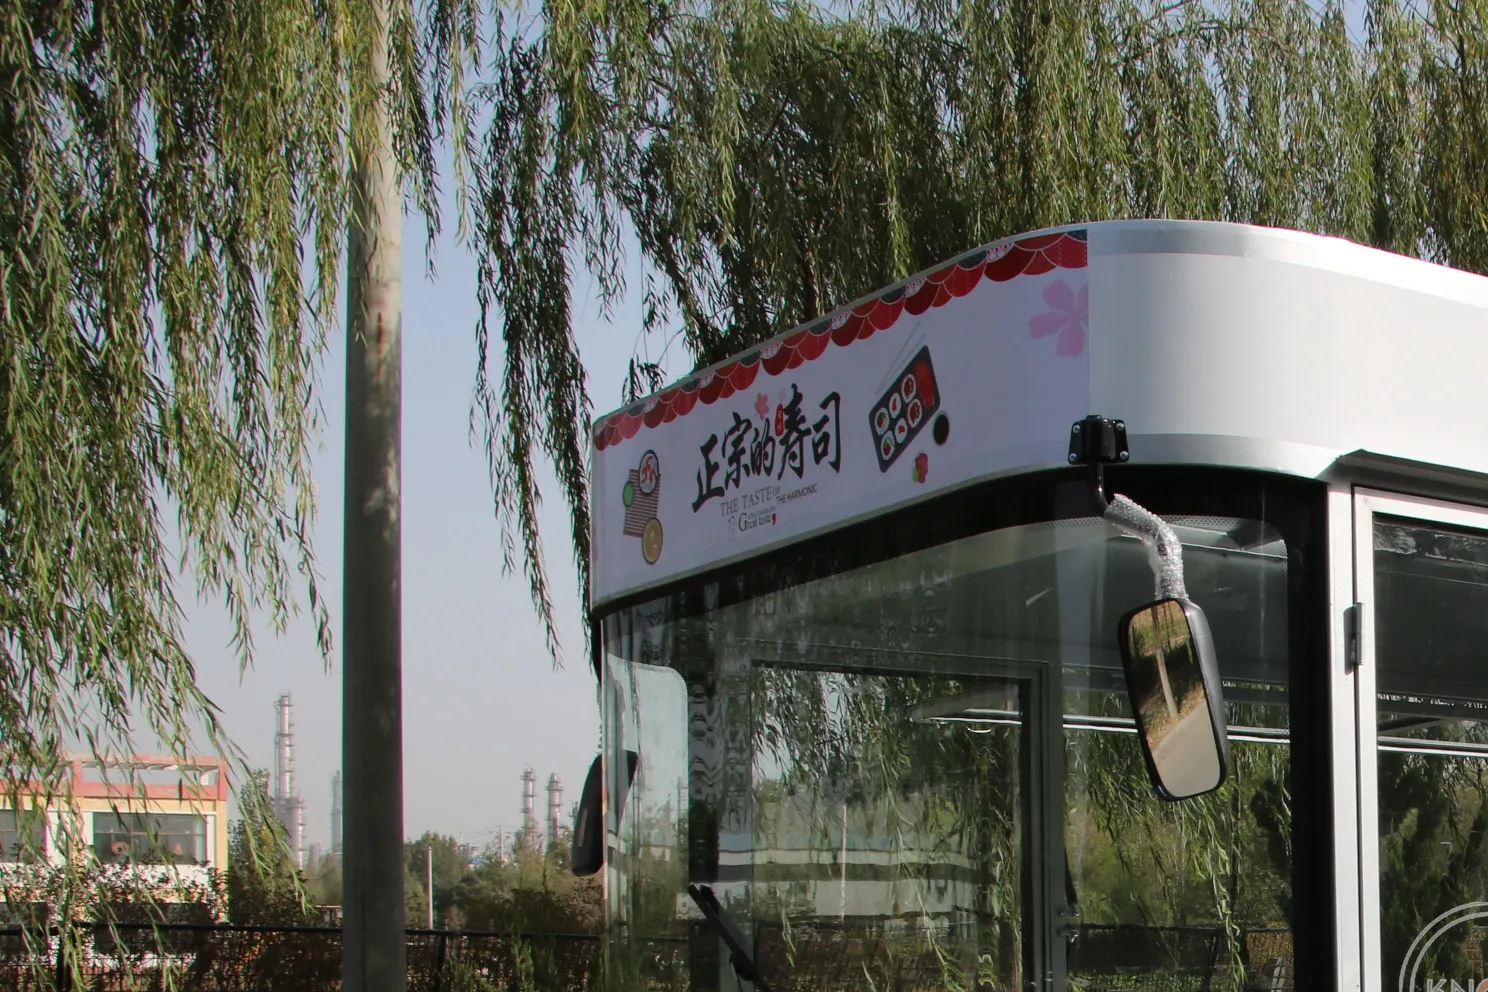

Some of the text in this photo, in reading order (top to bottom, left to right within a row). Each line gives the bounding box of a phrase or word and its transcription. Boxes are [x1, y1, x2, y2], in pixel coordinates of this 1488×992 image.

[692, 383, 841, 513] 正宗的寿司
[721, 499, 739, 517] THE
[742, 485, 772, 510] TASTE
[776, 483, 818, 505] THE HARMONIC
